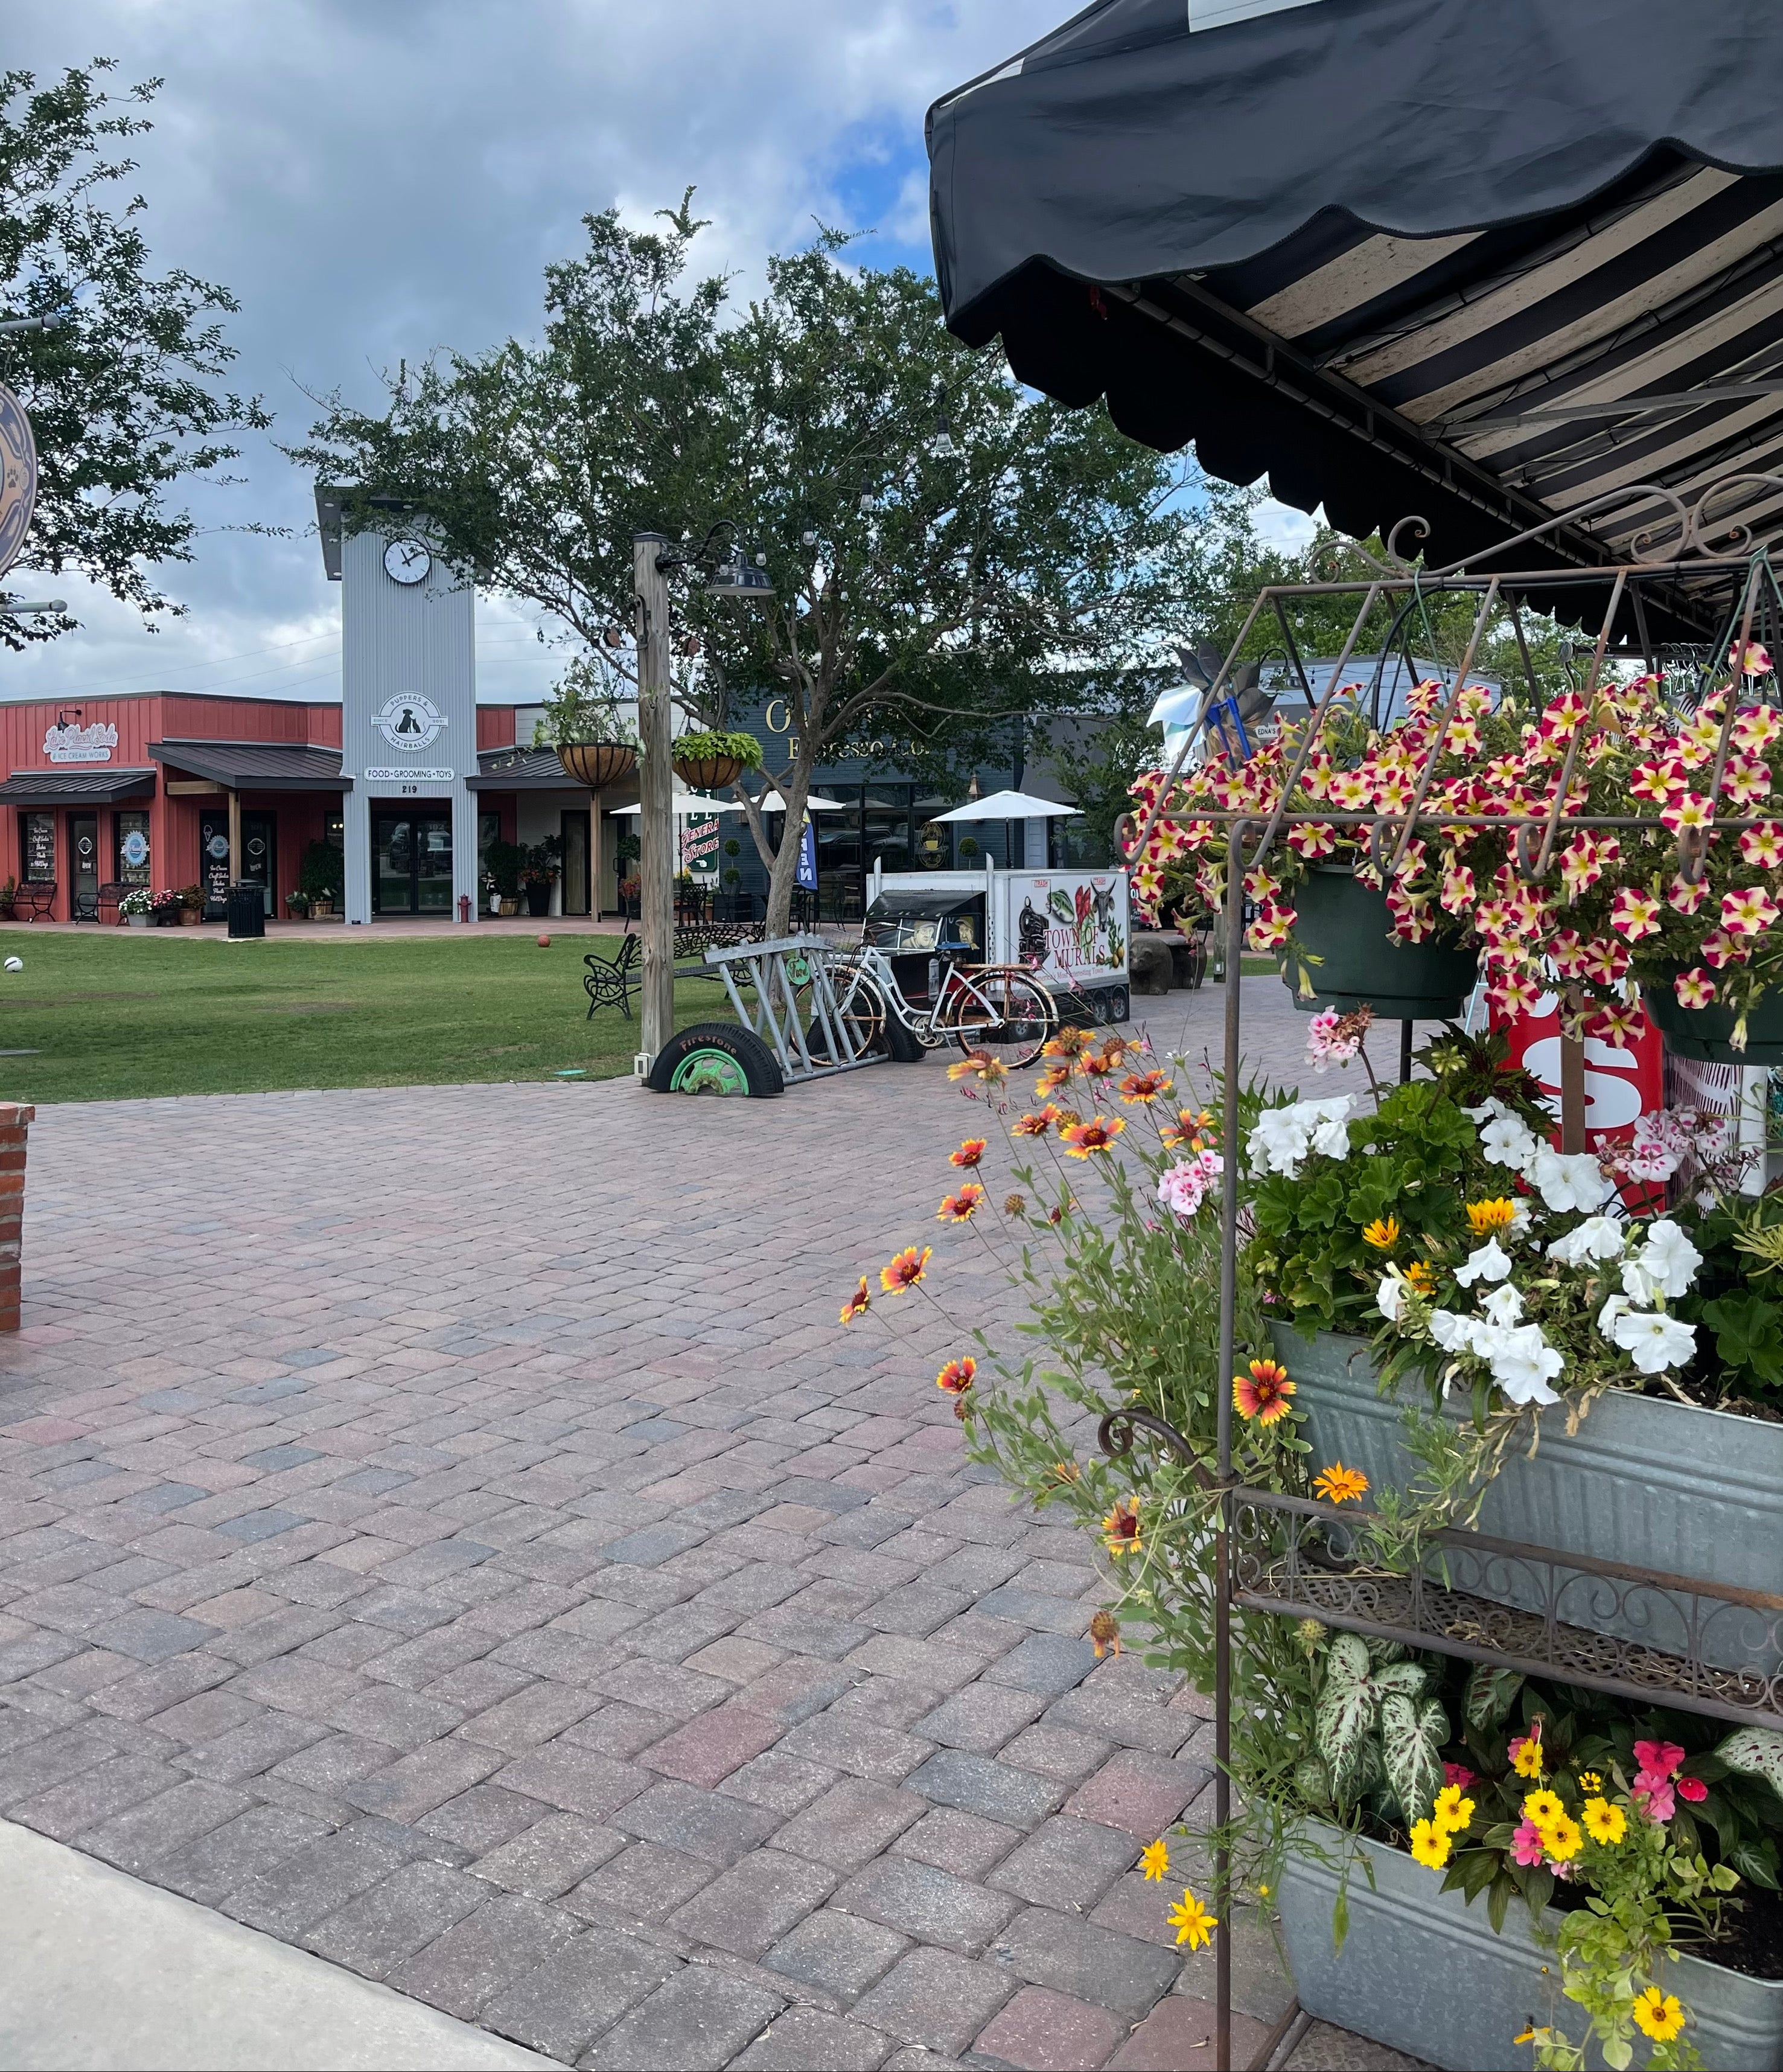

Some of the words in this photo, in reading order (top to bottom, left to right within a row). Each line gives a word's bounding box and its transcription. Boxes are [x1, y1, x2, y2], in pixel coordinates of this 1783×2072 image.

[391, 695, 421, 706] PUPPERS
[45, 728, 66, 750] Lake
[65, 726, 95, 746] Placid
[94, 726, 116, 745] Soda
[391, 737, 430, 749] HAIRBALLS
[1044, 927, 1081, 950] TOWN
[1085, 926, 1099, 945] OF
[1054, 945, 1105, 969] MURALS
[789, 959, 808, 978] Ford
[679, 1035, 737, 1055] Firestone
